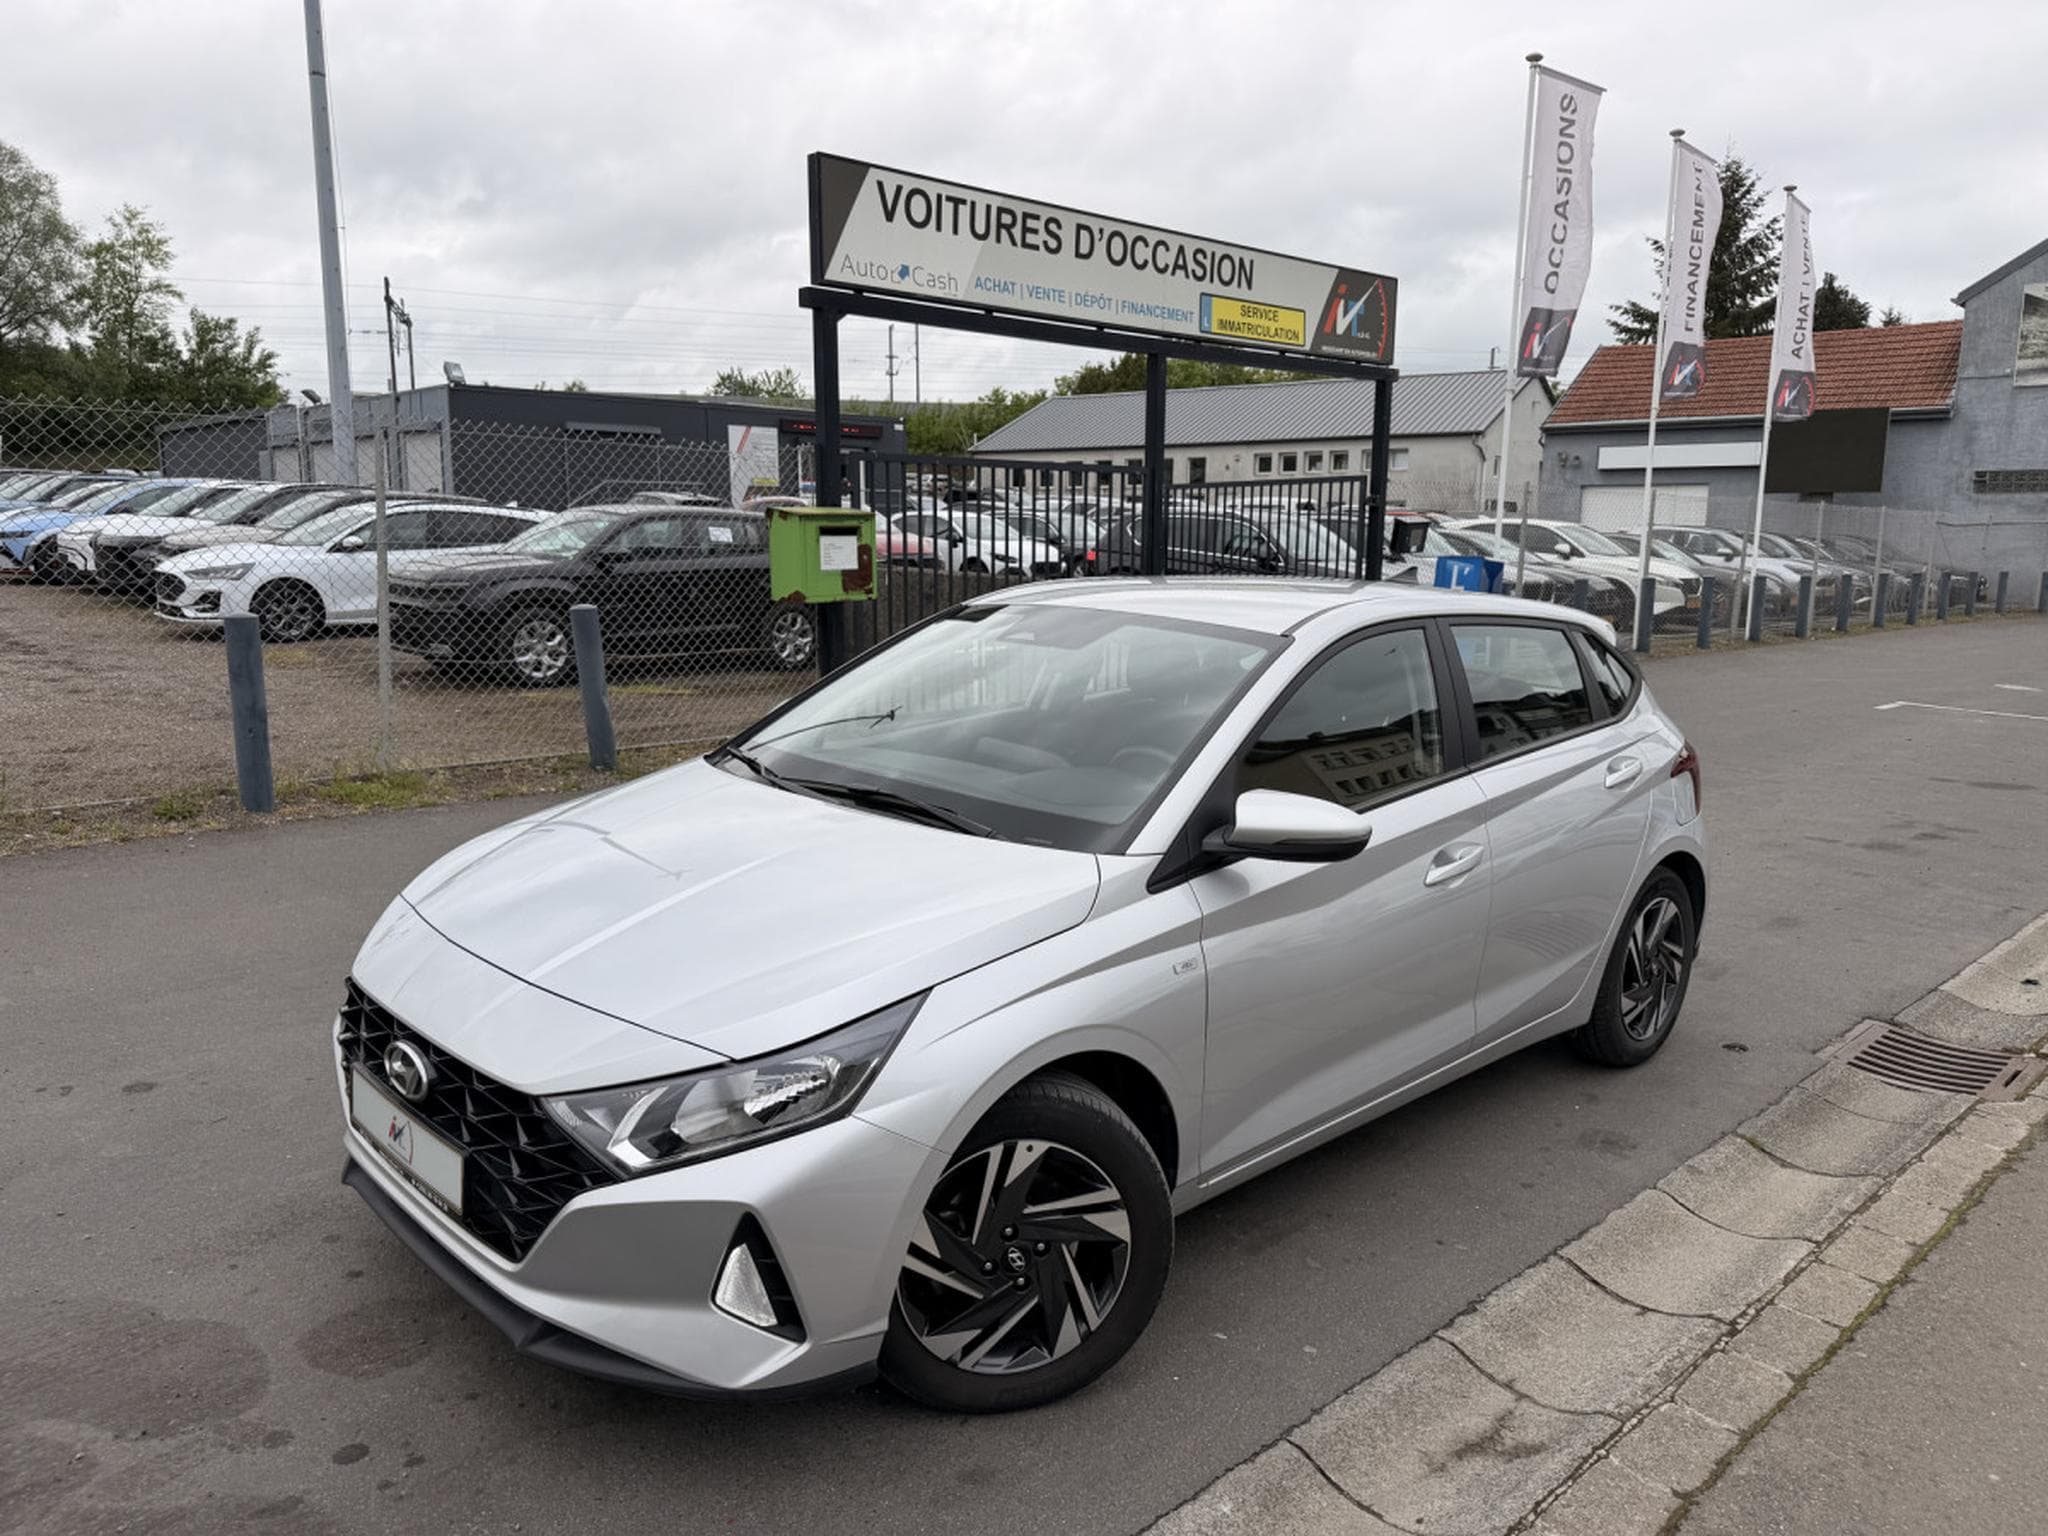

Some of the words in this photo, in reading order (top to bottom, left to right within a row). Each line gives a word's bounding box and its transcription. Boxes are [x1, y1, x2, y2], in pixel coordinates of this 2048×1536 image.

[1544, 92, 1578, 295] OCCASIONS
[876, 180, 1063, 255] VOITURES
[1074, 222, 1254, 290] D’OCCASION
[840, 253, 888, 281] Auto
[912, 266, 958, 292] Cash
[975, 276, 1016, 297] ACHAT
[1027, 284, 1066, 304] VENTE
[1075, 292, 1112, 310] DÉPÔT
[1121, 300, 1194, 323] FINANCEMENT
[1240, 305, 1279, 322] SERVICE
[1217, 318, 1300, 342] IMMATRICULATION
[1791, 291, 1811, 359] ACHAT
